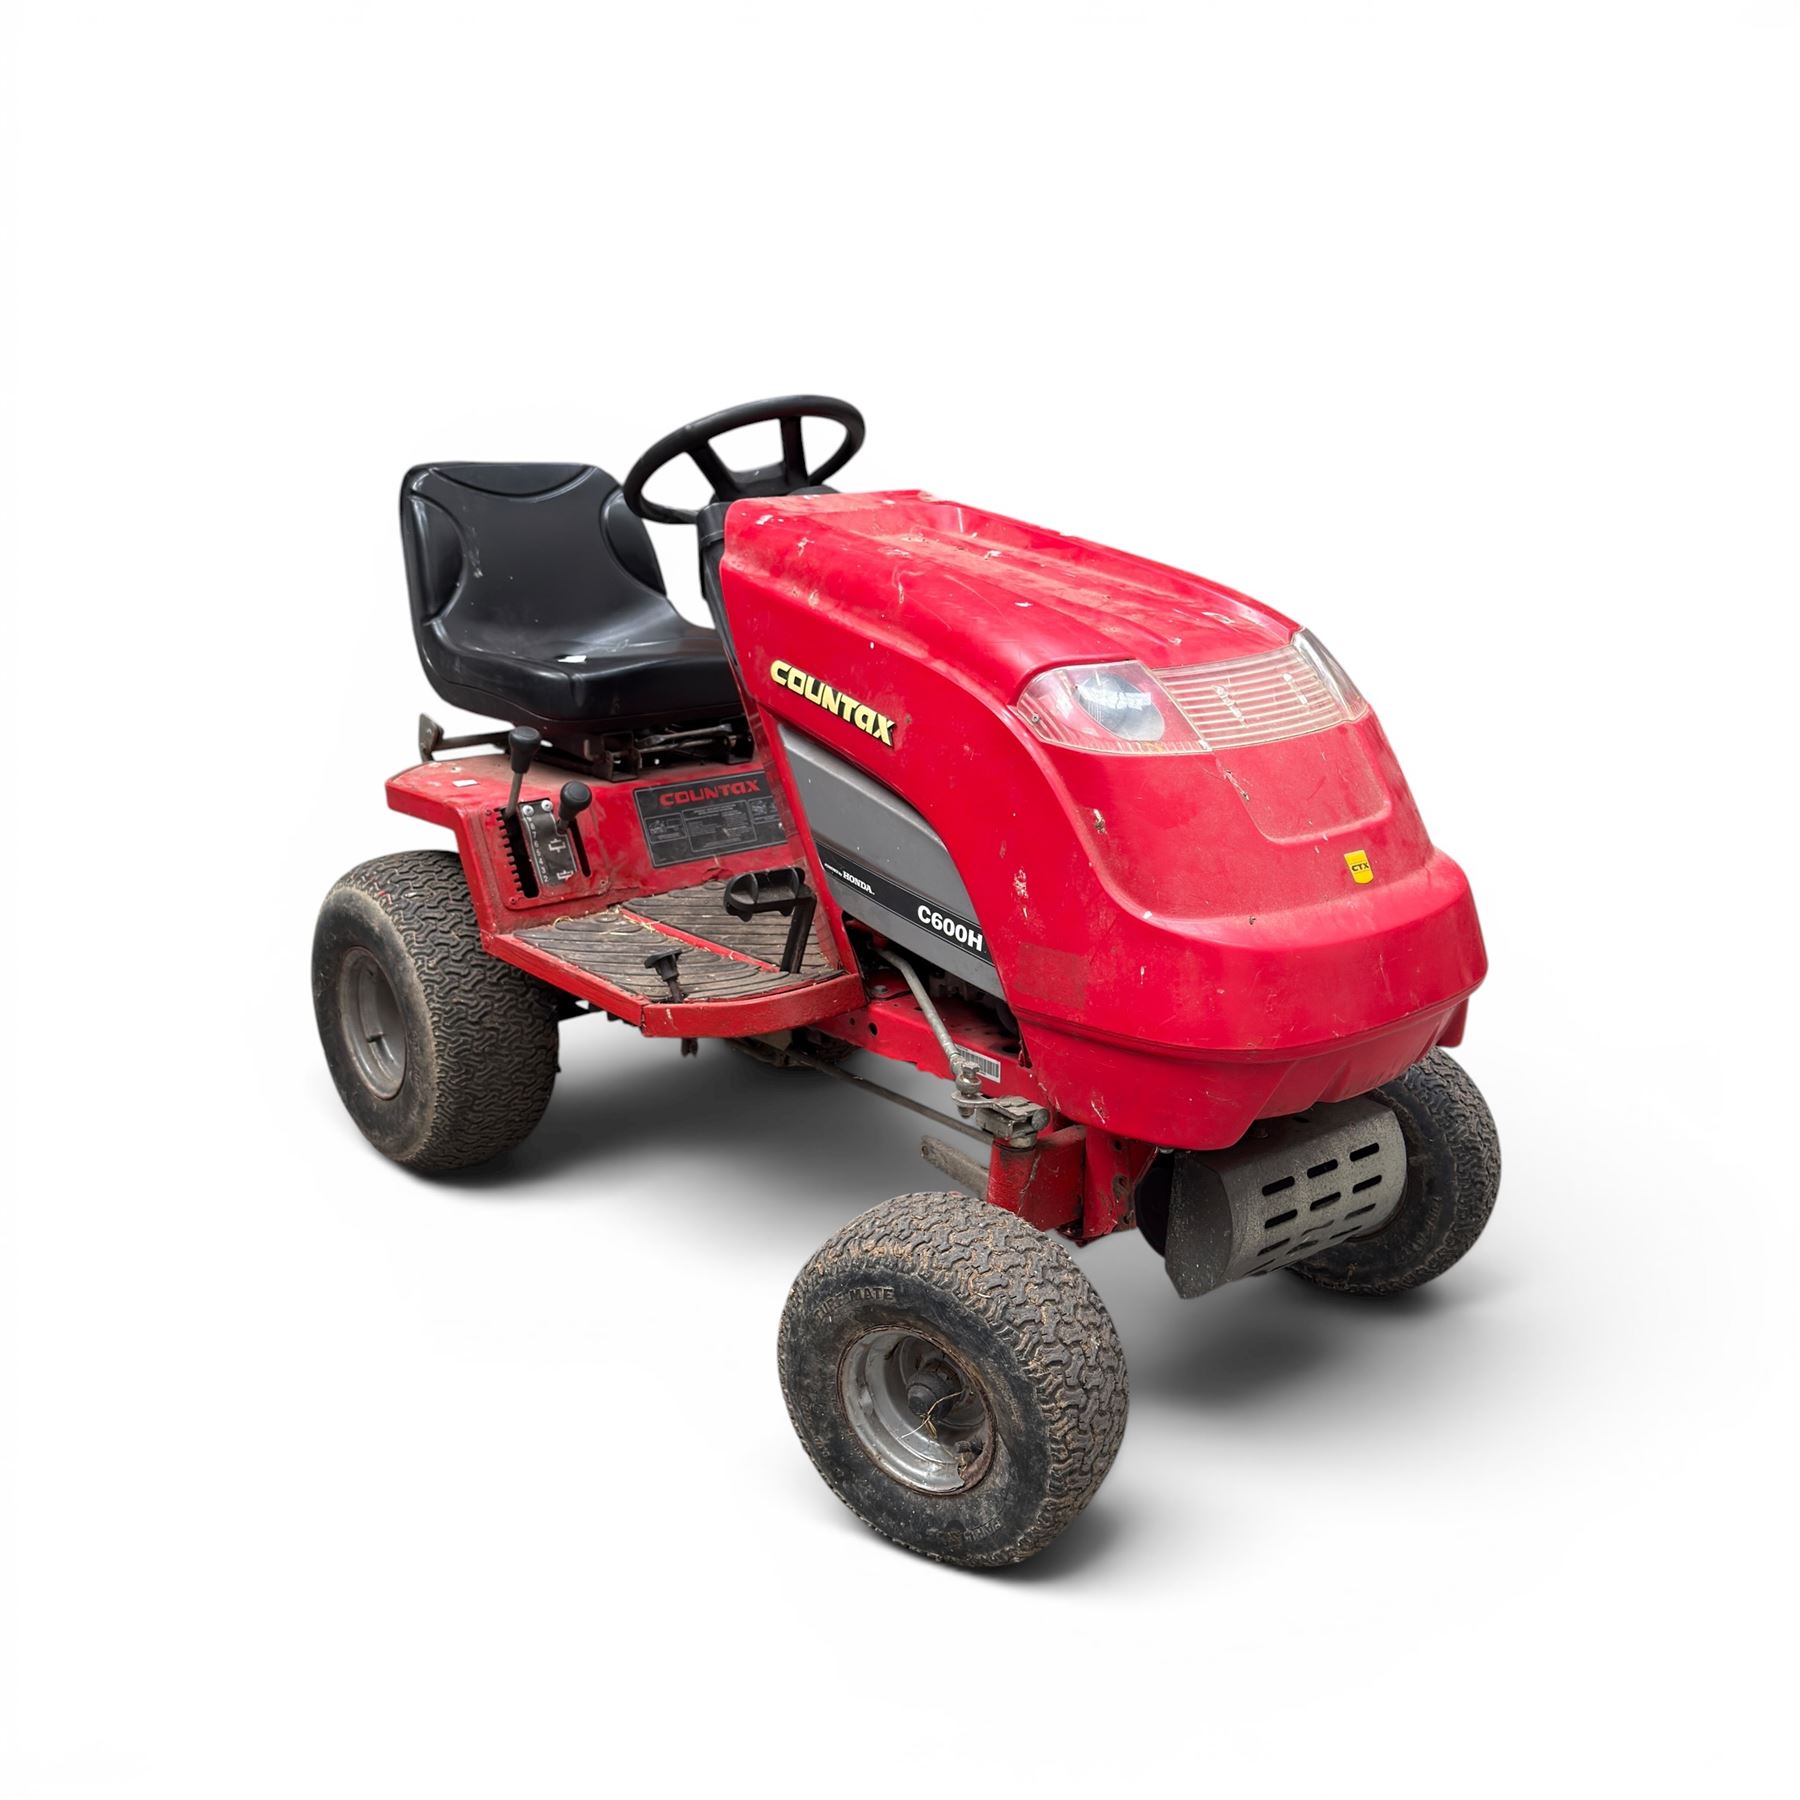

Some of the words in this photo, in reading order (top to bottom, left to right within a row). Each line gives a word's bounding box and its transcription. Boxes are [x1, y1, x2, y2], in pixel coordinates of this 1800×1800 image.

[769, 659, 895, 747] COUNTAX
[659, 779, 761, 807] COUNTAX
[1351, 862, 1370, 872] CTX
[917, 904, 984, 952] C600H
[849, 1286, 895, 1301] MATE
